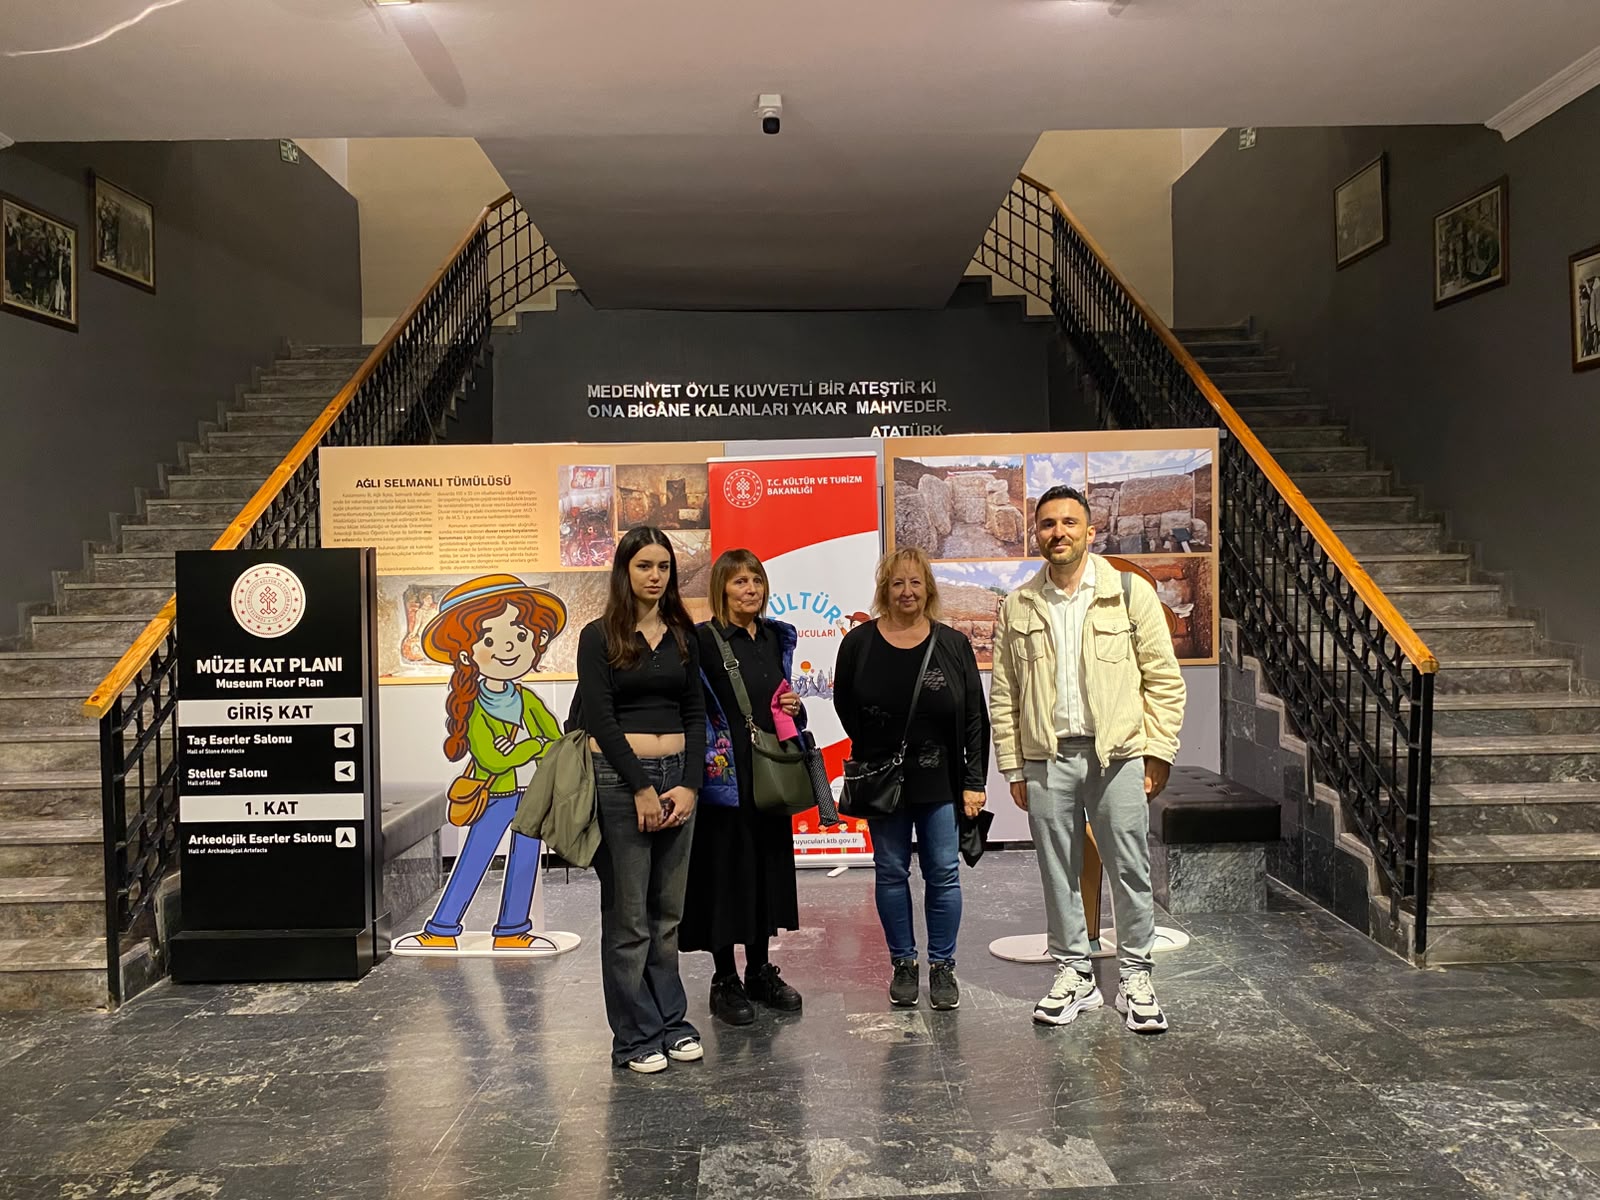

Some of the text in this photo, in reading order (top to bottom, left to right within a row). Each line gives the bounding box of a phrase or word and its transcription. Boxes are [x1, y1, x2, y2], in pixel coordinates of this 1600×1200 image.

[587, 381, 682, 399] MEDENİYET
[685, 381, 730, 398] ÖYLE
[734, 380, 813, 398] KUVVETLİ
[818, 380, 845, 396] BİR
[848, 378, 916, 398] ATEŞTİR
[587, 399, 952, 418] ONA BİGÂNE KALANLARI YAKAR MAHVEDER.
[870, 422, 944, 438] ATATÜRK
[355, 474, 512, 489] AĞLI SELMANLI TÜMÜLÜSÜ
[767, 475, 862, 487] T.C. KÜLTÜR VE TURİZM
[767, 486, 813, 495] BAKANLIĞI
[766, 591, 842, 625] ÜLTÜR
[797, 629, 836, 638] UCULARI
[196, 655, 343, 674] MÜZE KAT PLANI
[215, 678, 324, 688] Museum Floor Plan
[227, 702, 313, 722] GİRİŞ KAT
[187, 734, 293, 747] Taş Eserler Salonu
[187, 767, 268, 779] Steller Salonu
[245, 801, 299, 815] 1. KAT
[188, 833, 332, 846] Arkeolojik Eserler Salonu
[793, 837, 858, 846] ruyuculari.ktb.gov.tr
